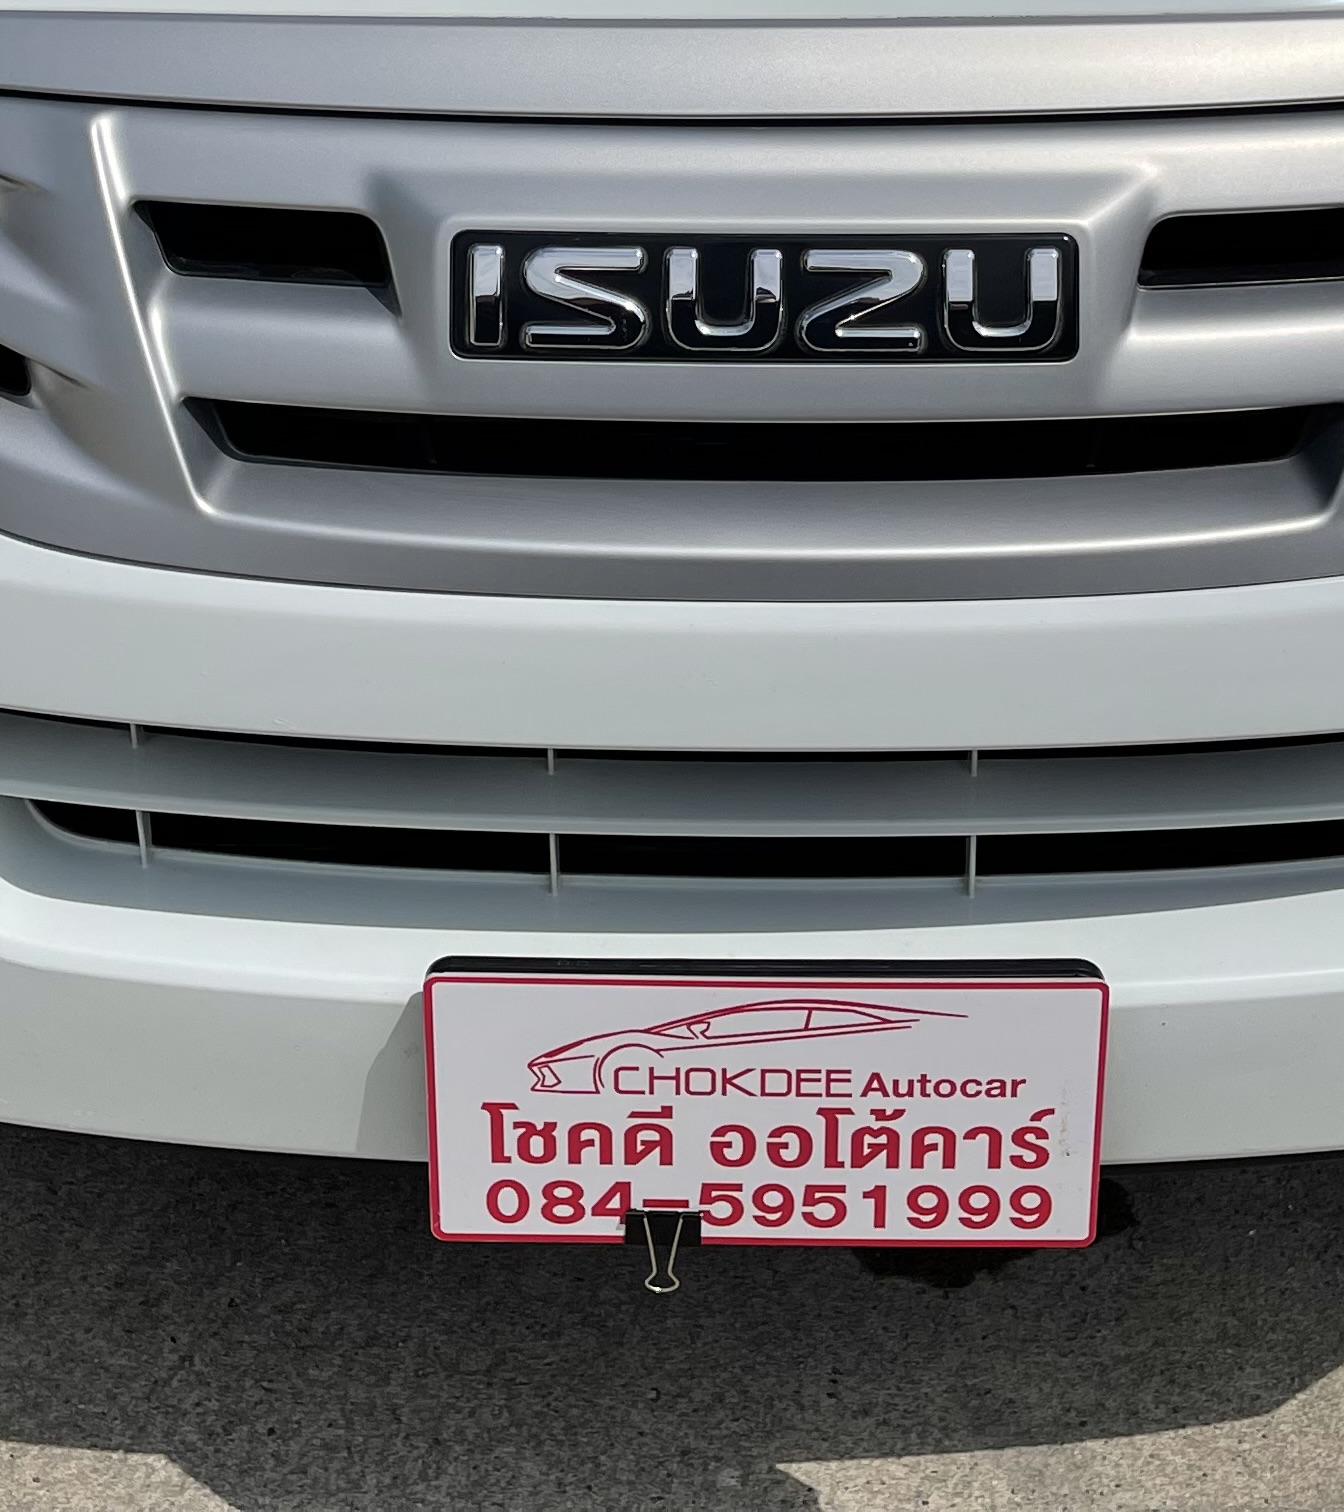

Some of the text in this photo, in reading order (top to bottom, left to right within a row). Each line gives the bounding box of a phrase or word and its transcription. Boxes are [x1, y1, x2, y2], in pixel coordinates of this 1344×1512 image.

[466, 243, 1062, 351] ISUZU
[612, 1066, 1027, 1100] CHOKDEE Autocar
[481, 1101, 1056, 1170] โชคดี ออโต้คาร์
[485, 1178, 1054, 1230] 084-5951999
